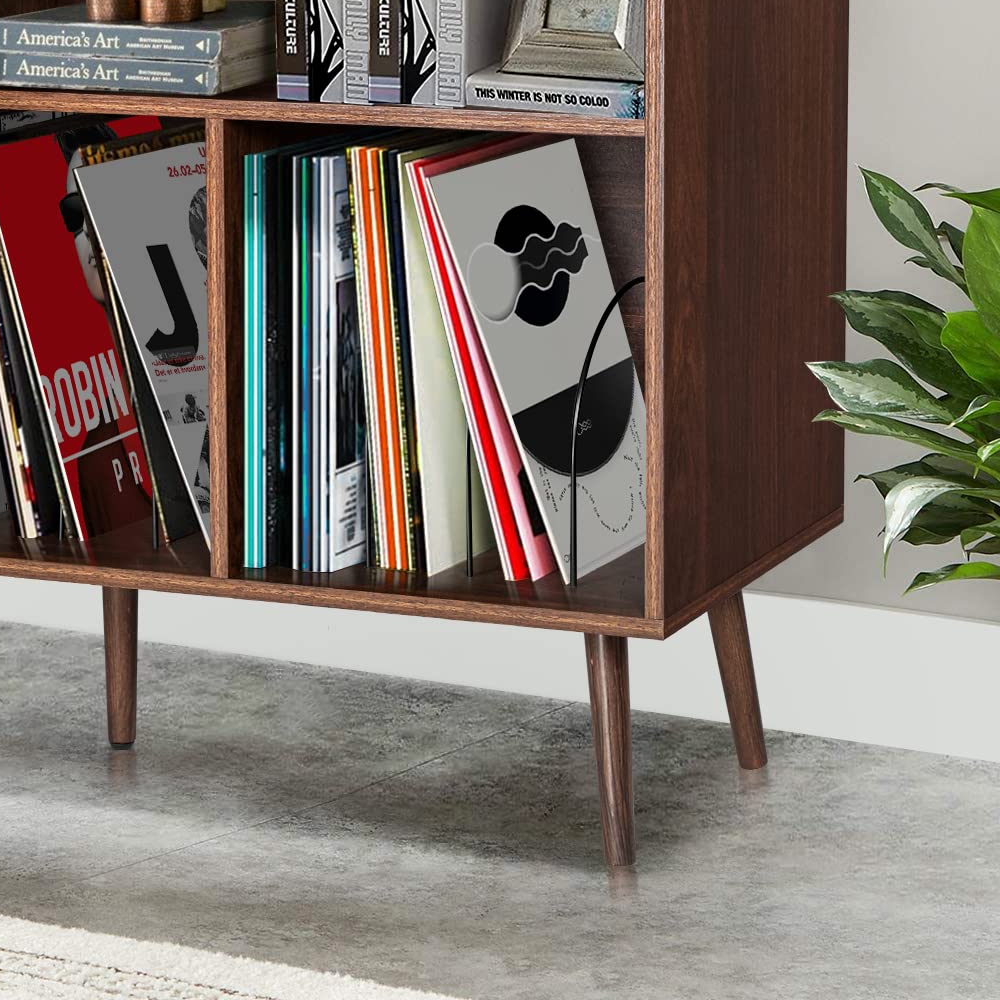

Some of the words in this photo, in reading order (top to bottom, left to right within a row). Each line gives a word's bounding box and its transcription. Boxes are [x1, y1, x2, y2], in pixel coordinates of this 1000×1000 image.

[16, 28, 90, 47] America's
[93, 31, 120, 49] Art
[16, 59, 90, 78] America's
[93, 63, 119, 81] Art
[346, 50, 369, 101] MAN
[437, 52, 463, 103] MAN
[474, 87, 496, 99] THIS
[496, 88, 531, 101] WINTER
[533, 92, 542, 102] IS
[544, 93, 564, 104] NOT
[564, 94, 577, 105] SO
[579, 95, 610, 108] COLOD
[145, 243, 199, 367] J
[40, 349, 130, 443] ROBIN
